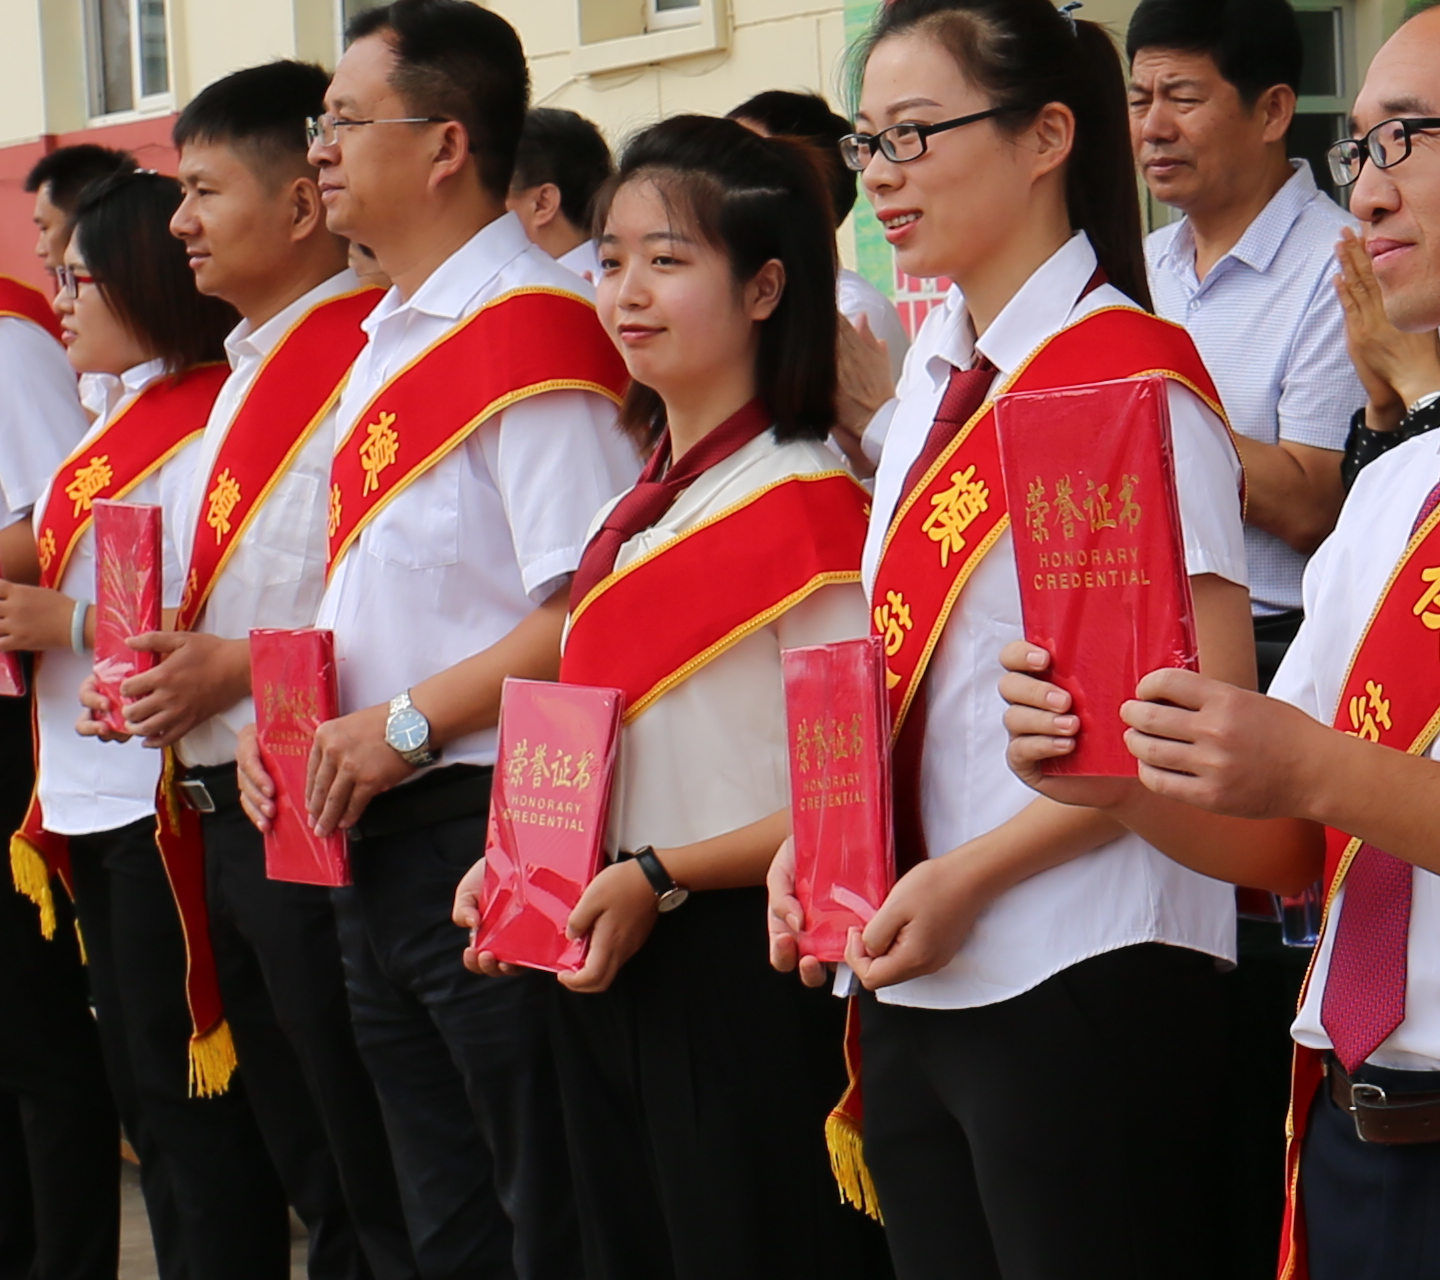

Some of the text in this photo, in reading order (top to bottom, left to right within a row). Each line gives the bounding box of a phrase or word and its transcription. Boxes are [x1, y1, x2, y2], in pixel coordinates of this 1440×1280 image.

[1024, 473, 1143, 545] 荣誉证书
[1038, 546, 1140, 569] HONORARY
[1033, 569, 1152, 591] CREDENTIAL
[508, 737, 595, 794] 荣誉证书
[510, 793, 583, 815] HONORARY
[503, 808, 586, 833] CREDENTIAL
